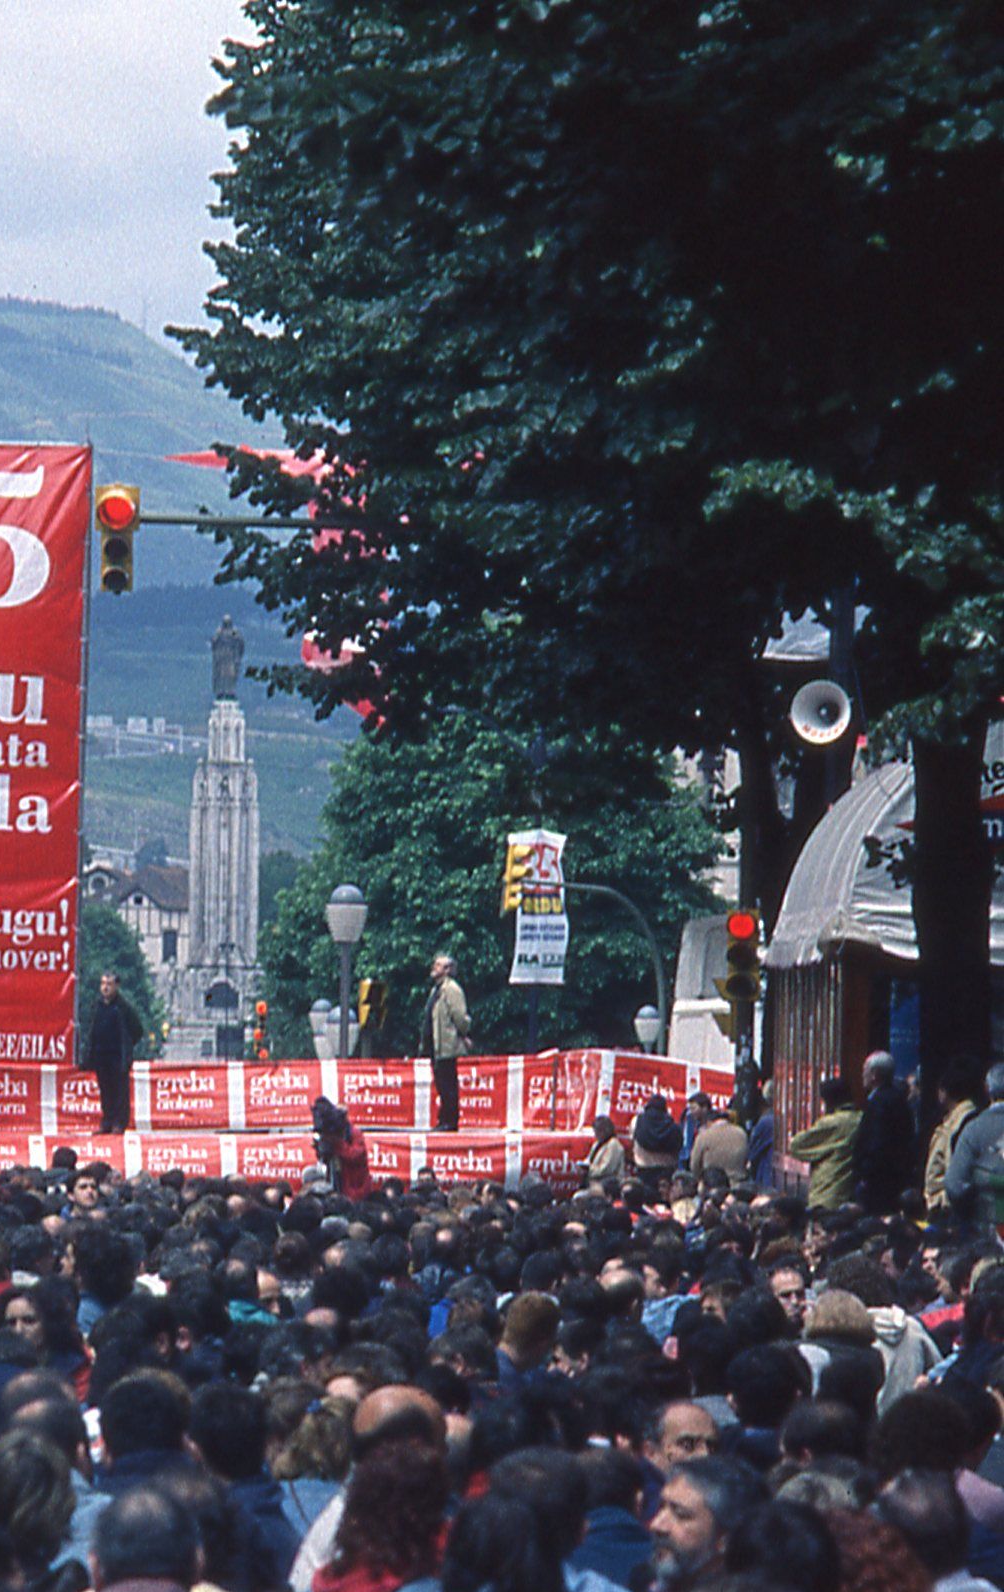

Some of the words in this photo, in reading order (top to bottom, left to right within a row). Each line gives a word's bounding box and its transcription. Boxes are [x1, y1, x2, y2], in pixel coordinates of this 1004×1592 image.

[157, 1070, 214, 1099] greba
[250, 1068, 309, 1097] greba
[344, 1067, 402, 1094] greba
[457, 1067, 494, 1090] eba
[62, 1079, 100, 1104] gre
[148, 1144, 207, 1162] greba
[244, 1143, 303, 1165] greba
[433, 1150, 493, 1175] greba
